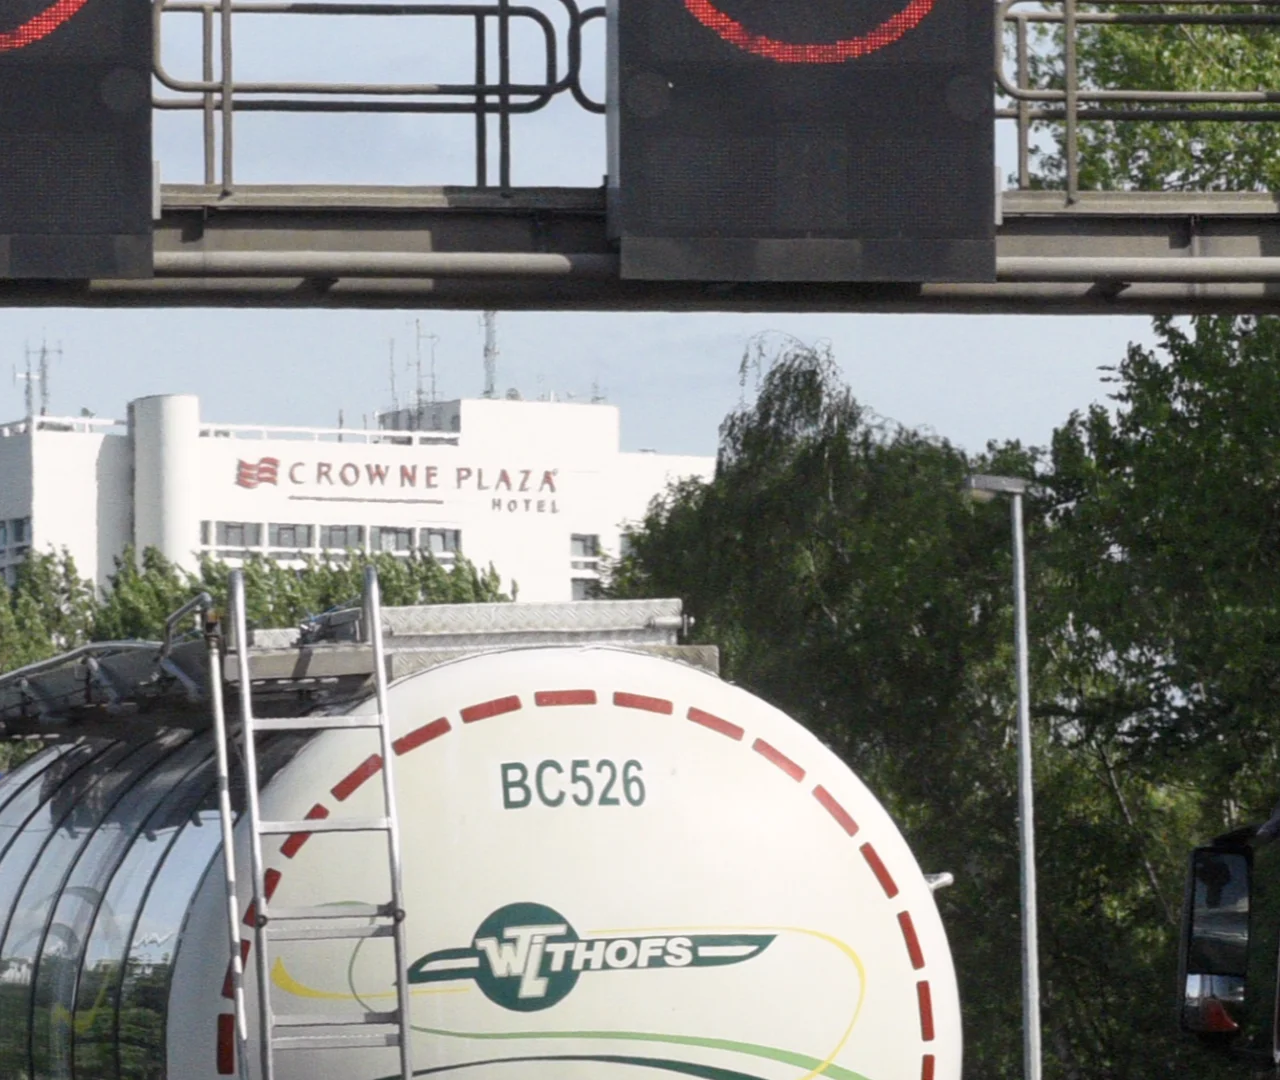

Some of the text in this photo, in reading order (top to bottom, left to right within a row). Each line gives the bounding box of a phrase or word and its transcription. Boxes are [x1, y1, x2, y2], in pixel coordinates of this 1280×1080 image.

[288, 461, 559, 493] CROWNE PLAZA
[491, 498, 560, 514] HOTEL
[500, 758, 647, 810] BC526
